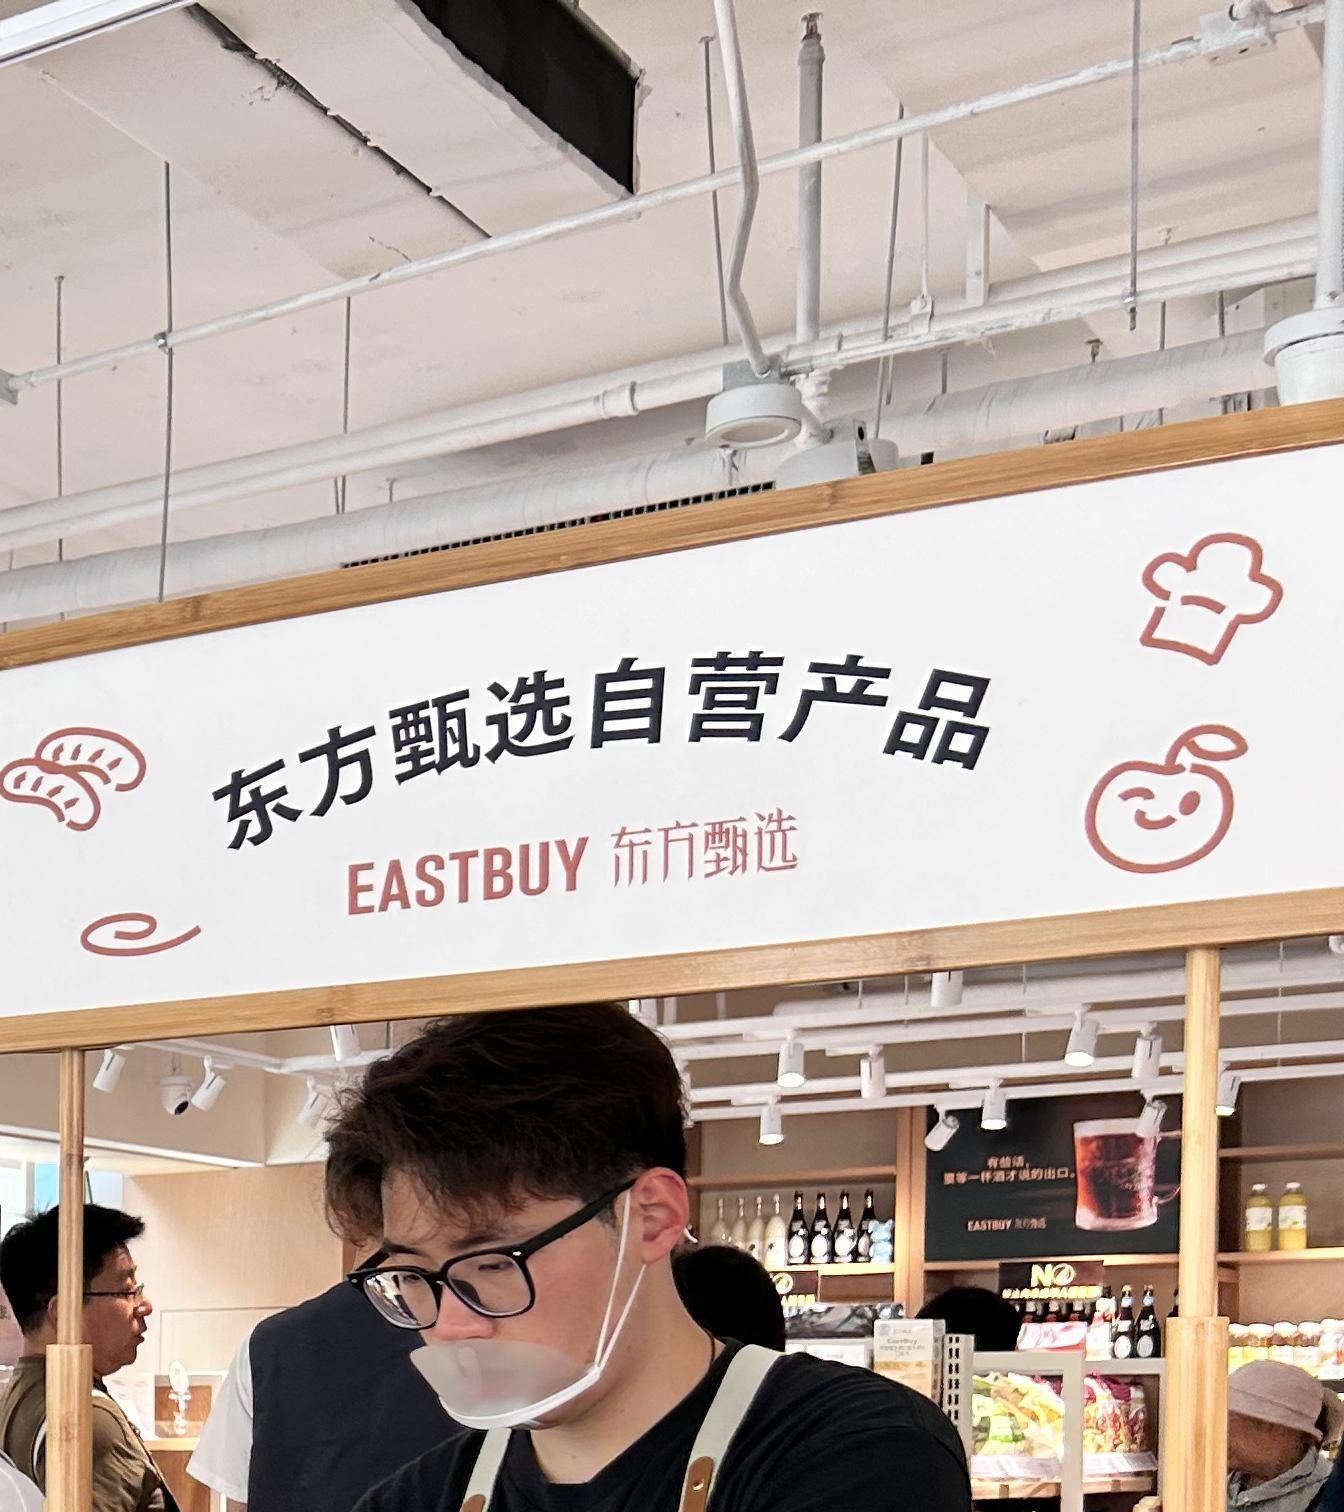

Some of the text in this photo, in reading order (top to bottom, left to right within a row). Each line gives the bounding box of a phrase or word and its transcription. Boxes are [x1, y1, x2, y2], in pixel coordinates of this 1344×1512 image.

[212, 650, 992, 852] 东方甄选自营产品
[346, 806, 798, 916] EASTBUY 东方甄选
